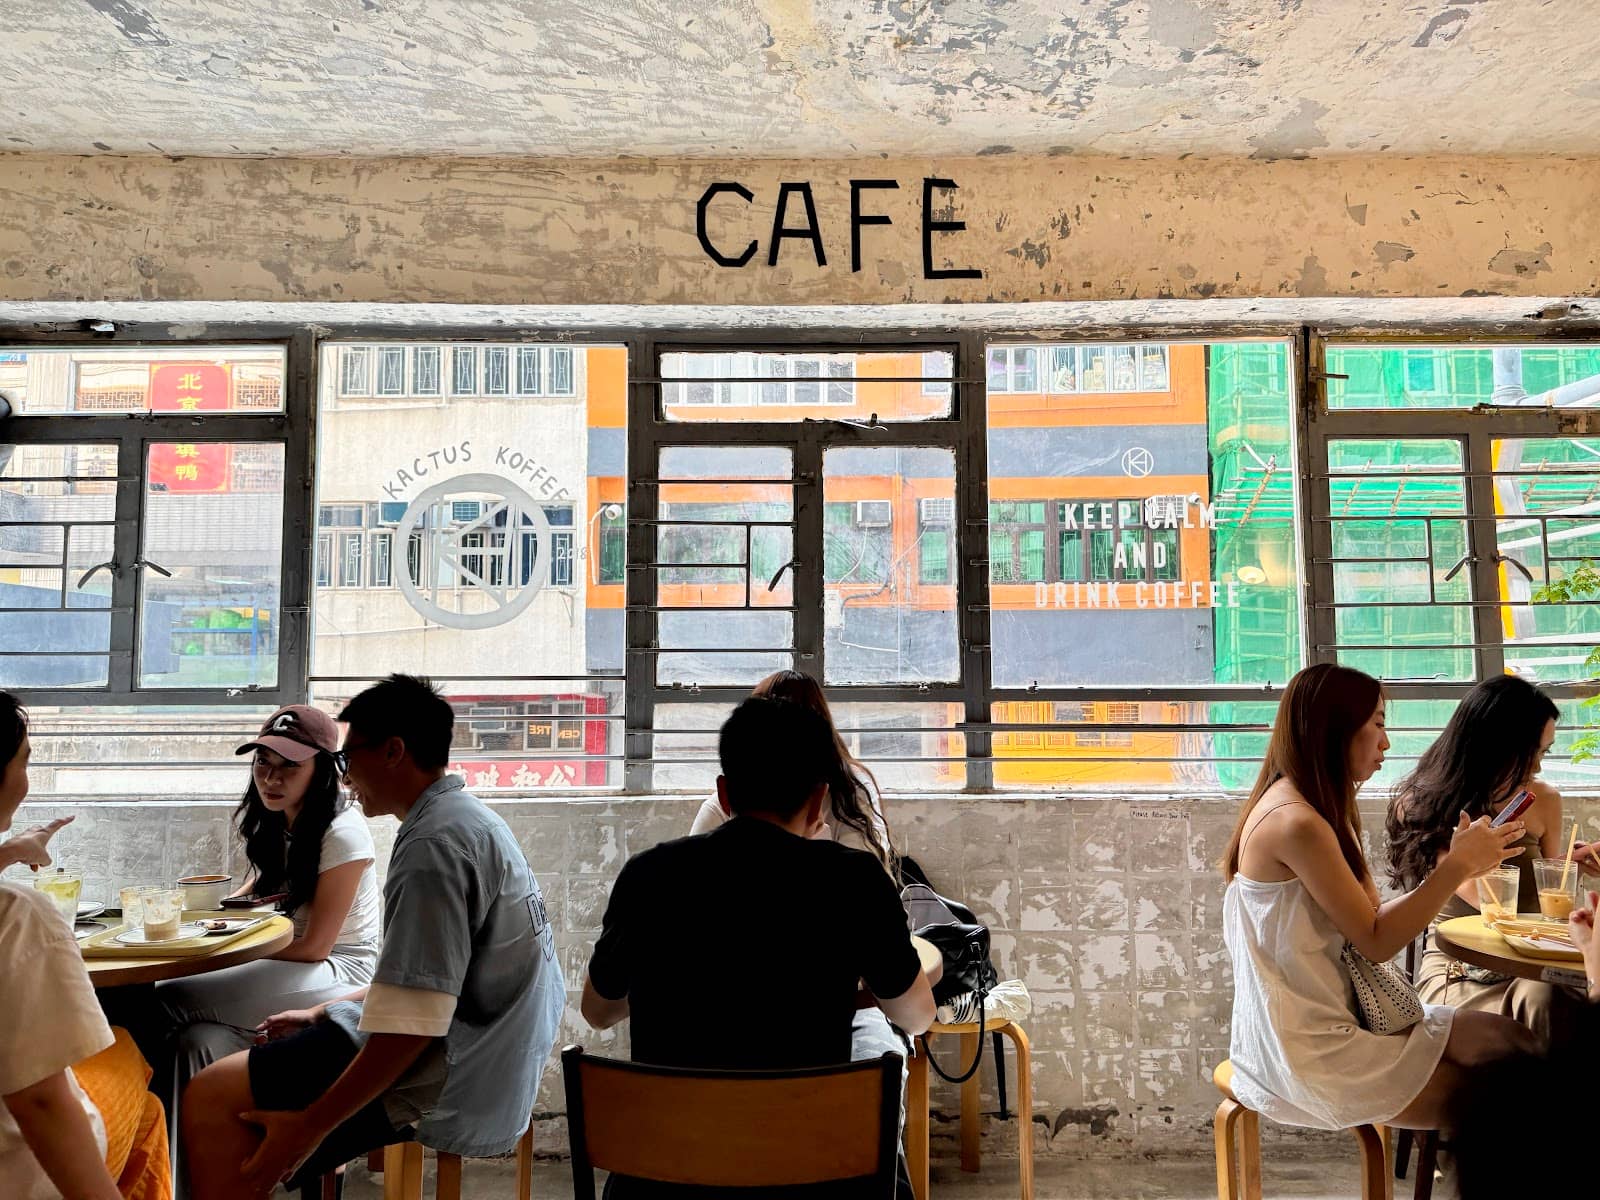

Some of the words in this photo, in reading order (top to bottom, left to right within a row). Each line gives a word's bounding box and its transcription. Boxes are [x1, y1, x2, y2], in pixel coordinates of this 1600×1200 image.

[697, 178, 982, 279] CAFE
[382, 441, 471, 500] KACTUS
[496, 446, 569, 506] KOFFEE
[1065, 503, 1132, 529] KEEP
[1147, 502, 1216, 530] CALM
[1114, 542, 1167, 569] AND
[1035, 582, 1120, 608] DRINK
[1136, 581, 1241, 608] COFFEE
